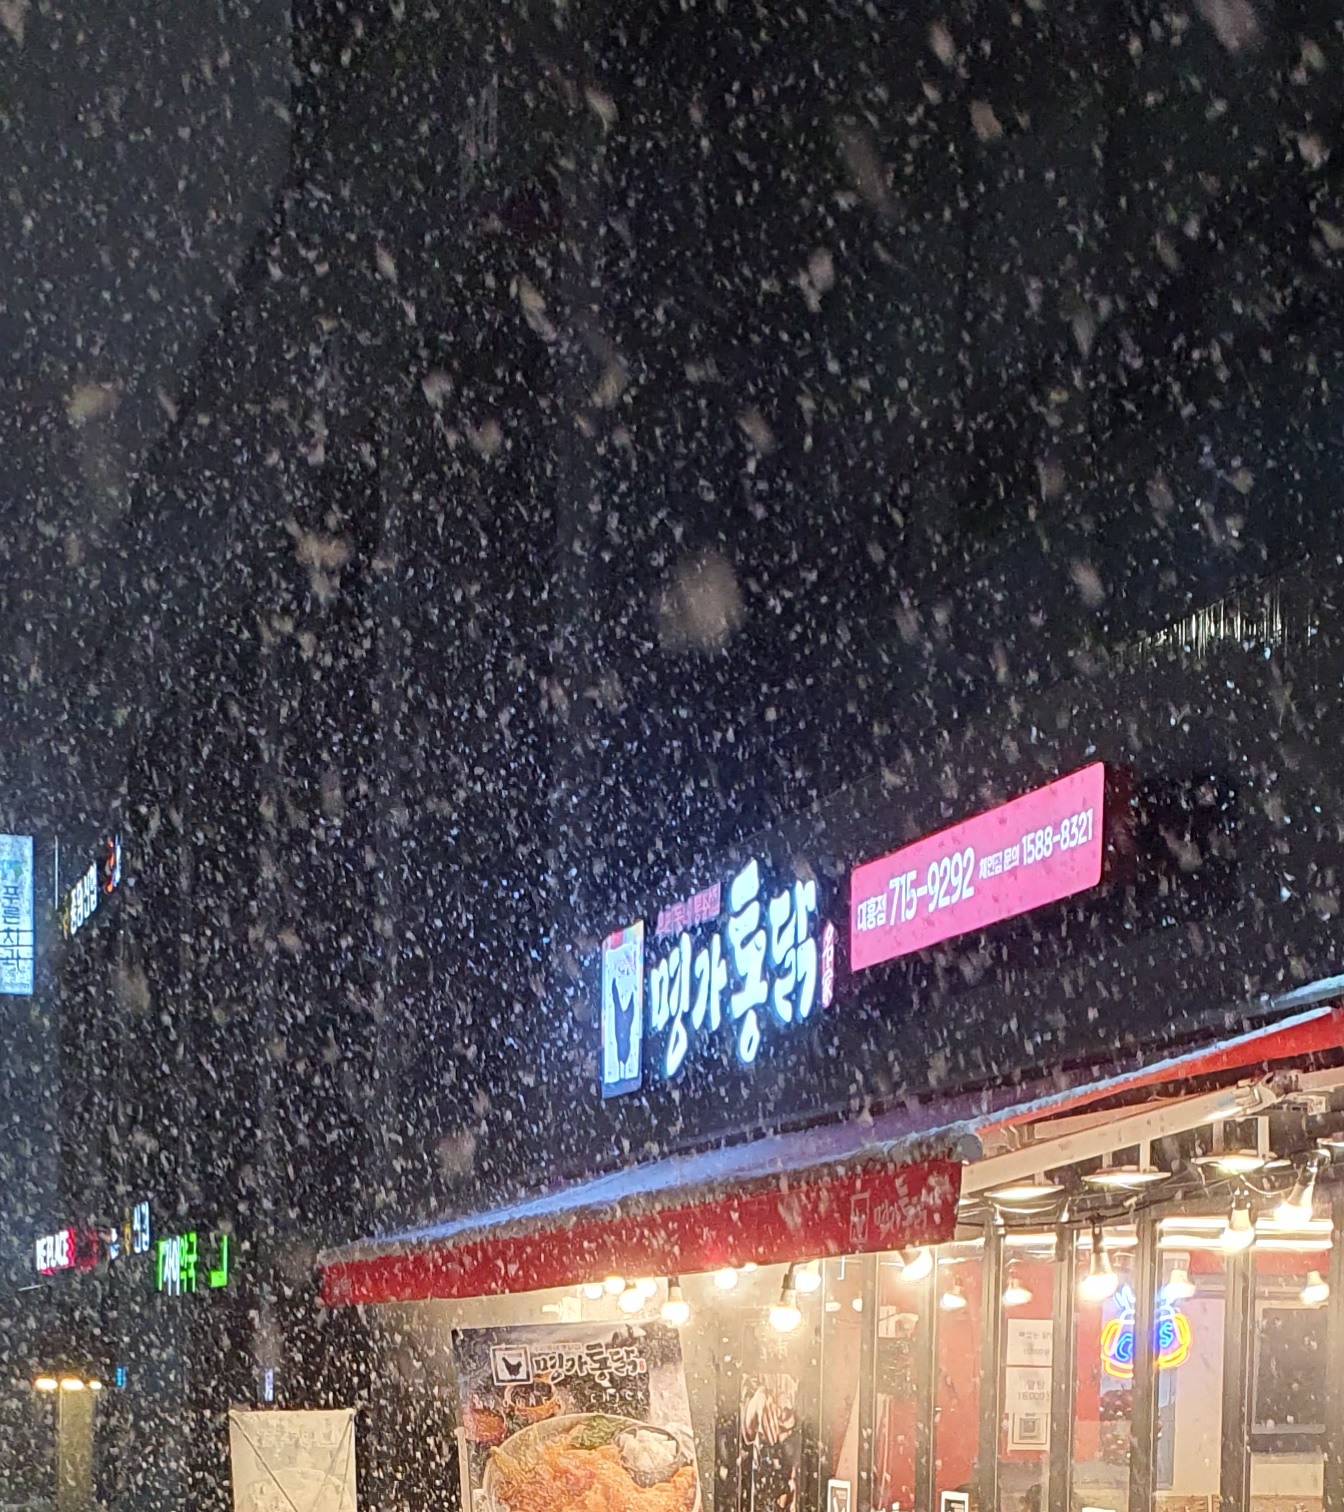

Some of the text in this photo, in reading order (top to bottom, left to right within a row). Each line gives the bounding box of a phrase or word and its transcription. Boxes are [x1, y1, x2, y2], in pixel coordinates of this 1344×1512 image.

[856, 893, 887, 931] 대흥점
[889, 846, 975, 926] 715-9292
[1004, 844, 1020, 871] 문의
[1022, 808, 1093, 866] 1588-8321
[2, 885, 23, 973] 푸른치과
[651, 857, 818, 1077] 명가통닭
[532, 1342, 639, 1386] 명가통닭
